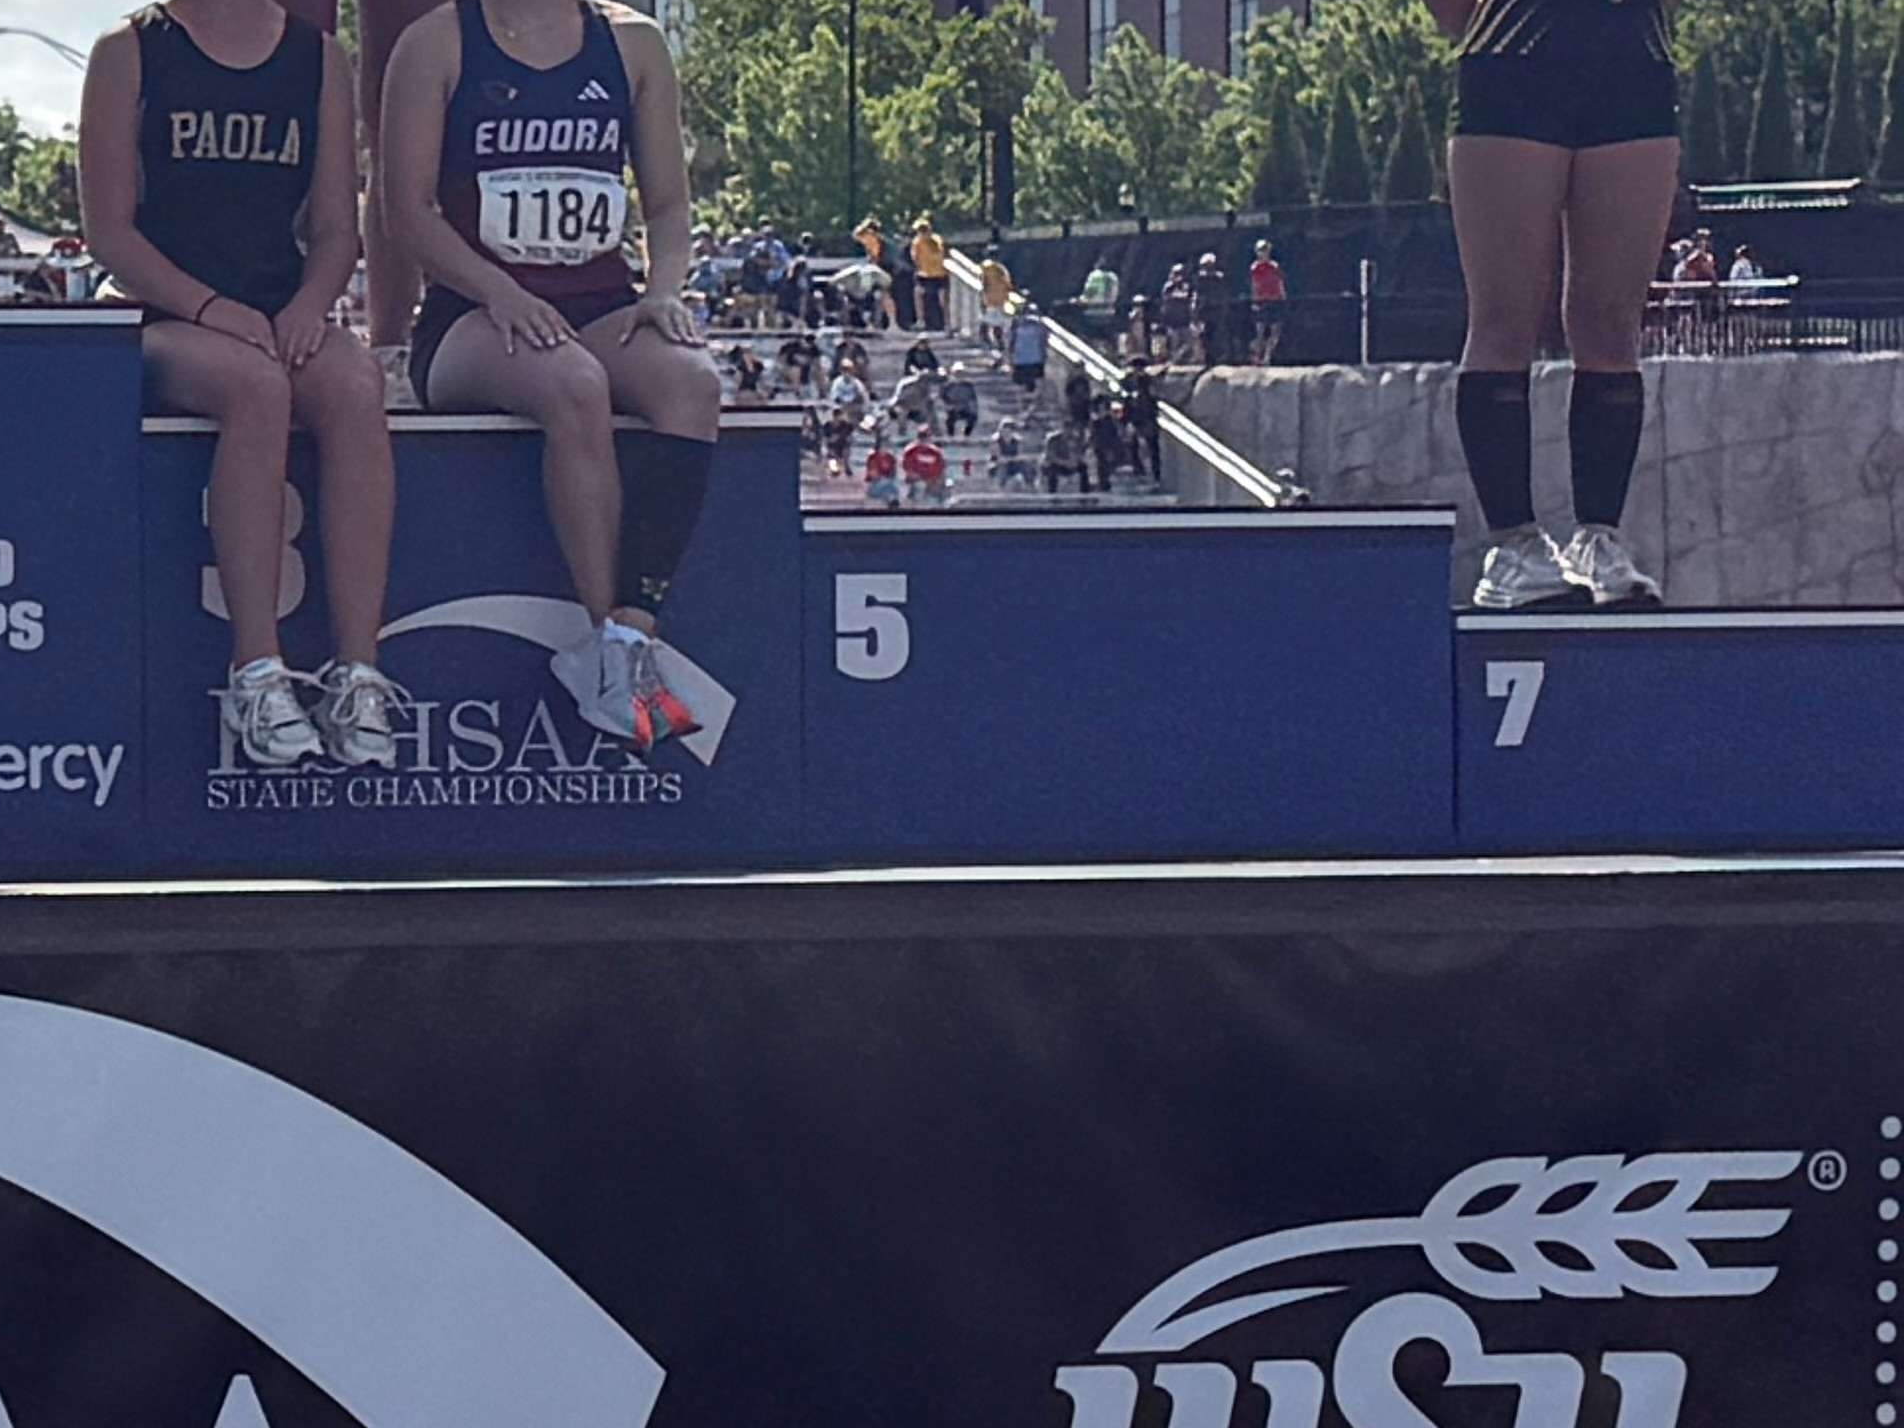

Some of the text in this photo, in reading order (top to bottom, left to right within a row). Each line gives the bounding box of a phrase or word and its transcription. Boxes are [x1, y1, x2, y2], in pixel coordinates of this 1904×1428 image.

[169, 109, 301, 165] PAOLA
[475, 118, 620, 155] EUDORA
[499, 187, 611, 245] 1184
[836, 574, 909, 679] 5
[208, 689, 648, 774] HSA
[1487, 662, 1545, 747] 7
[207, 774, 682, 809] STATE CHAMPIONSHIPS
